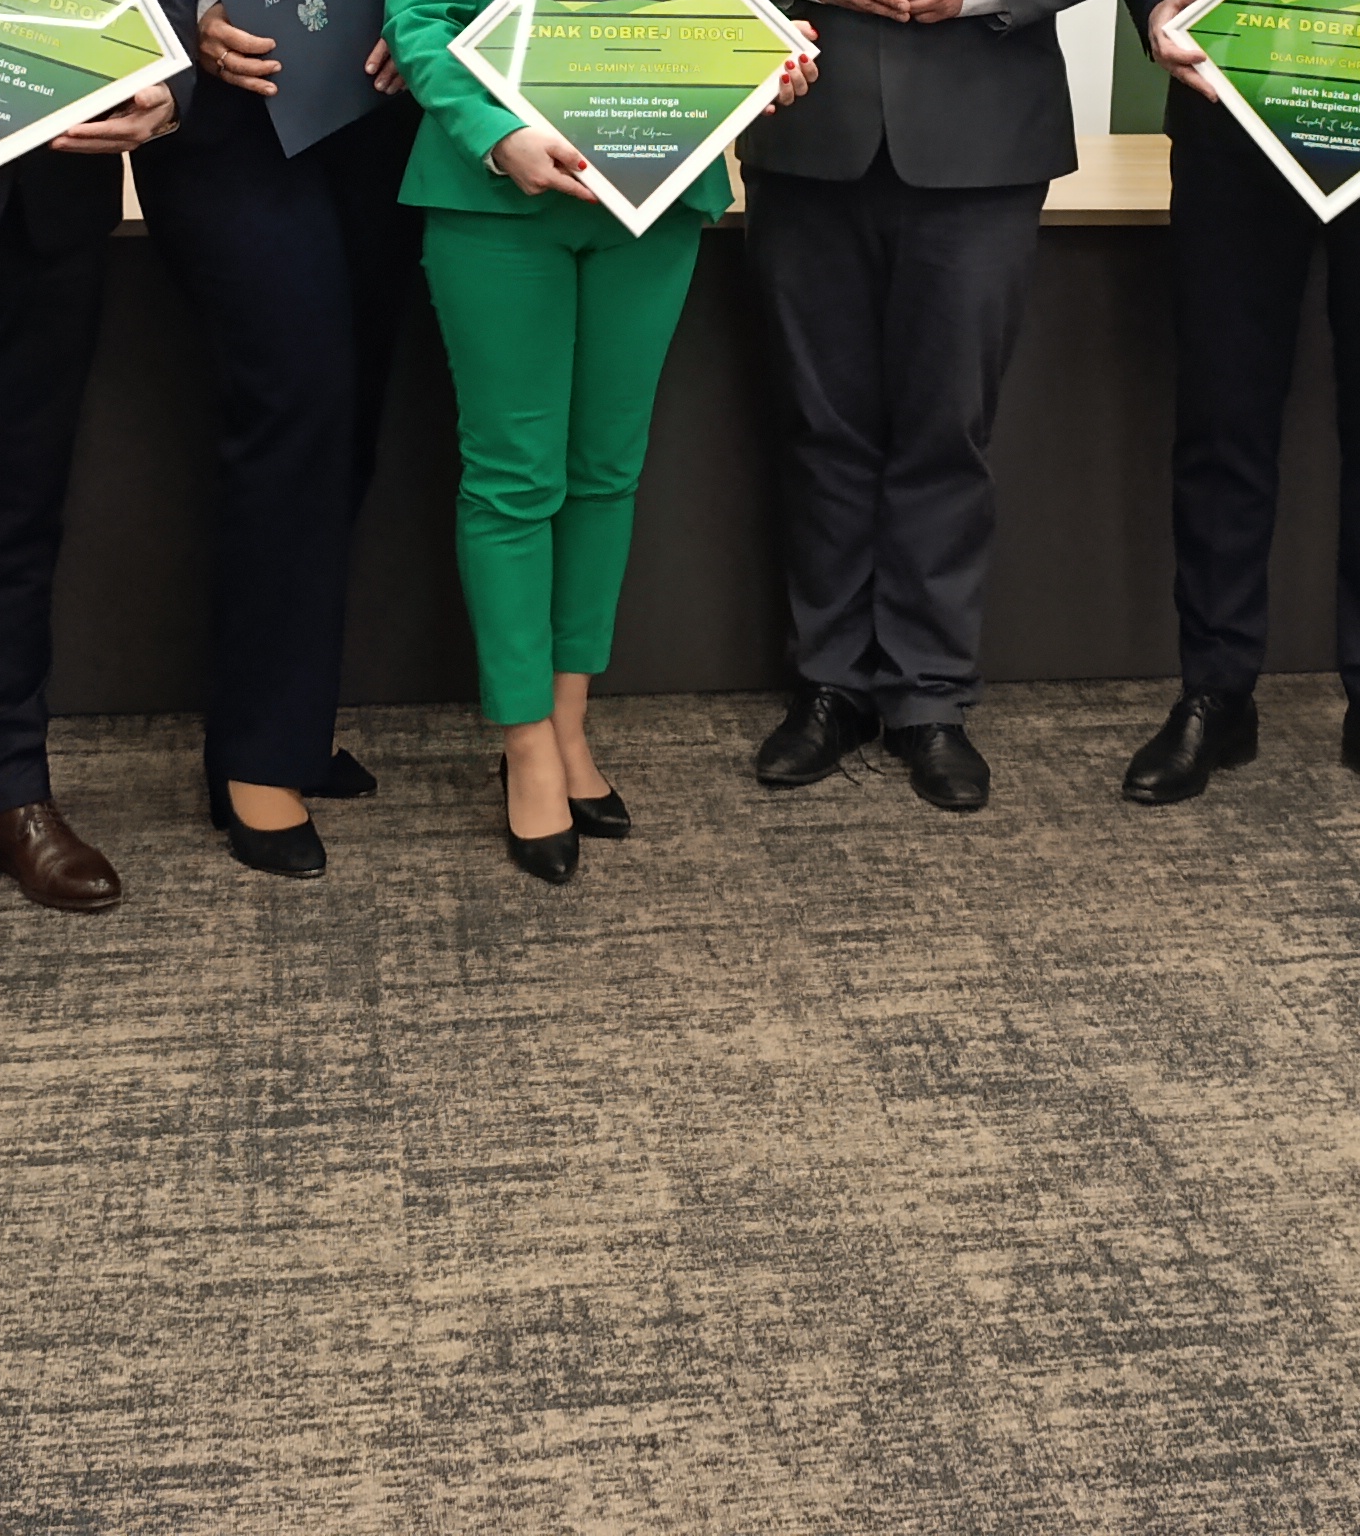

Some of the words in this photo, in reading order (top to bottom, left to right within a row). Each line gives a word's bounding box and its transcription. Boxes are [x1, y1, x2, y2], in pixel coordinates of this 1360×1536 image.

[1235, 13, 1292, 31] ZNAK
[529, 25, 581, 39] ZNAK
[590, 26, 672, 40] DOBREJ
[680, 27, 744, 41] DROGI
[1270, 51, 1293, 63] DLA
[1295, 54, 1336, 67] GMINY
[569, 63, 592, 72] DLA
[595, 63, 635, 72] GMINY
[639, 63, 701, 73] ALWERNA
[12, 78, 27, 88] do
[28, 82, 54, 96] celu!
[1291, 86, 1320, 97] Niech
[1321, 89, 1350, 100] każda
[589, 97, 617, 105] Niech
[620, 97, 649, 106] każda
[651, 97, 680, 108] droga
[1264, 96, 1310, 110] prowadzi
[563, 109, 608, 120] prowadzi
[611, 109, 668, 120] bezpiecznie
[670, 110, 681, 118] do
[684, 110, 708, 119] celu!
